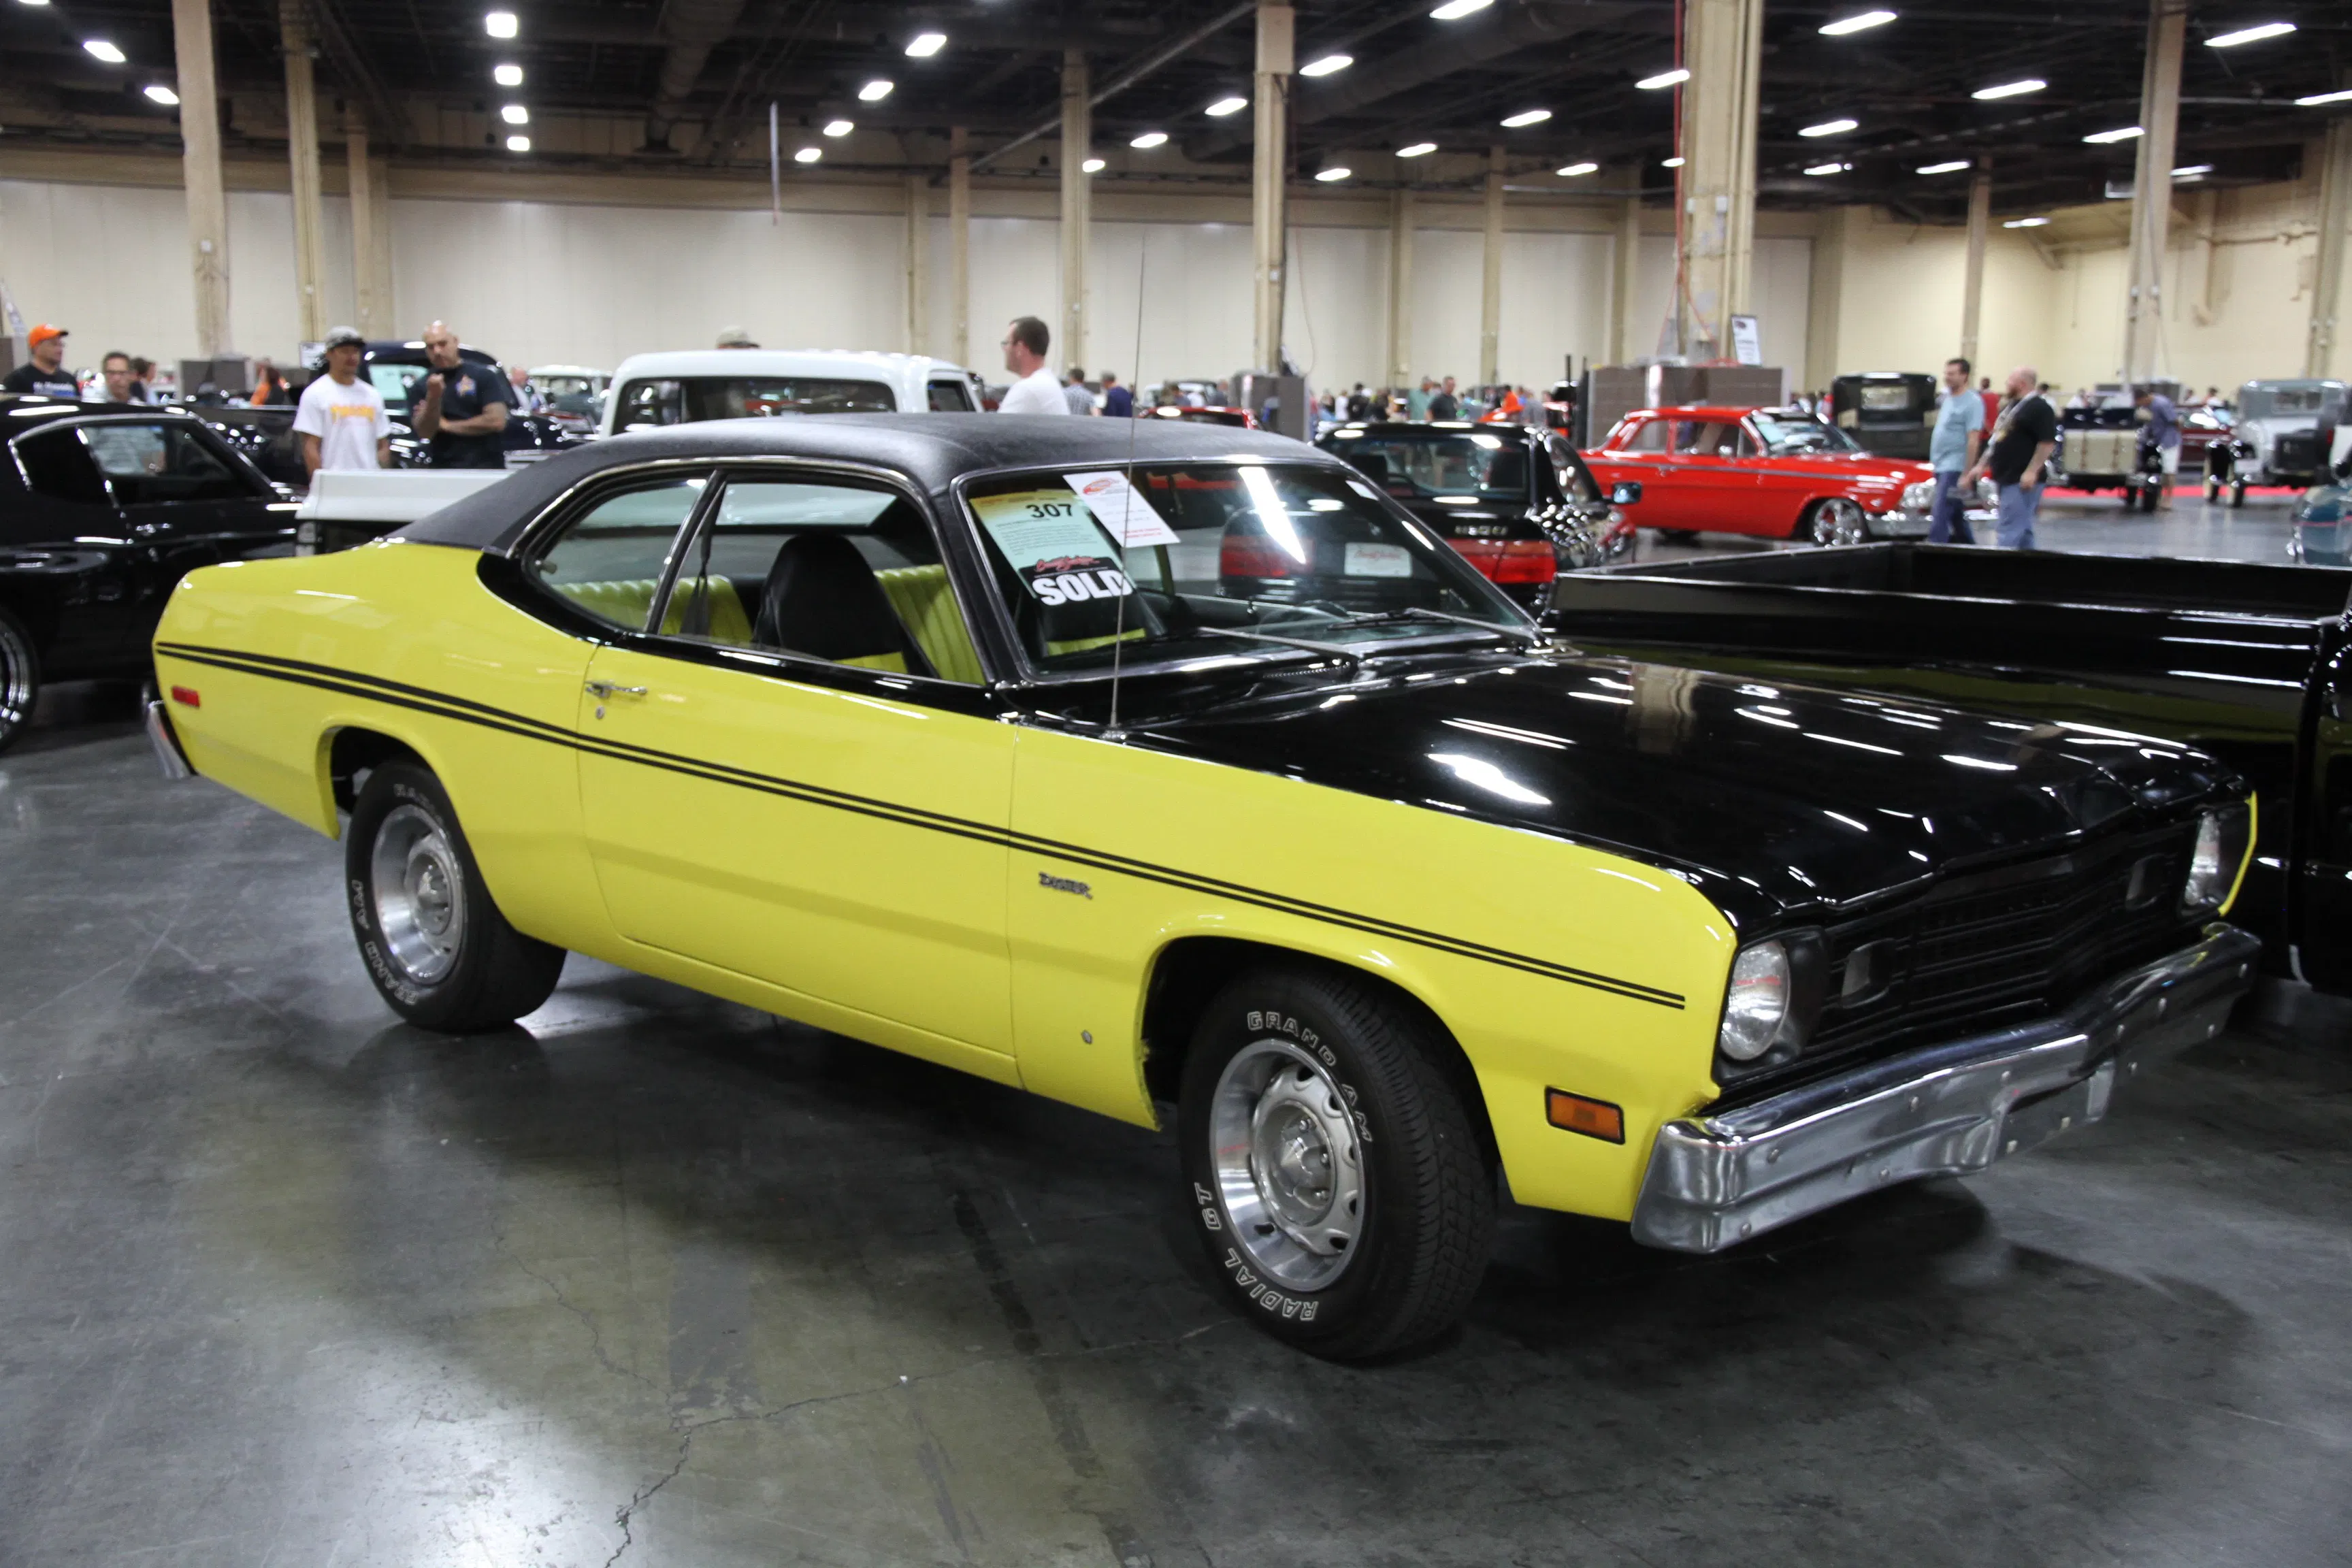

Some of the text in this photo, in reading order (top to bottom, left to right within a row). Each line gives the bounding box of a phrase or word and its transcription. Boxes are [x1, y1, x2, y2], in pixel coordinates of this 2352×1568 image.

[1026, 503, 1073, 519] 307
[1032, 570, 1133, 606] SOLD
[1247, 1011, 1373, 1143] GRAND AM
[1194, 1182, 1319, 1322] RADIAL GT
